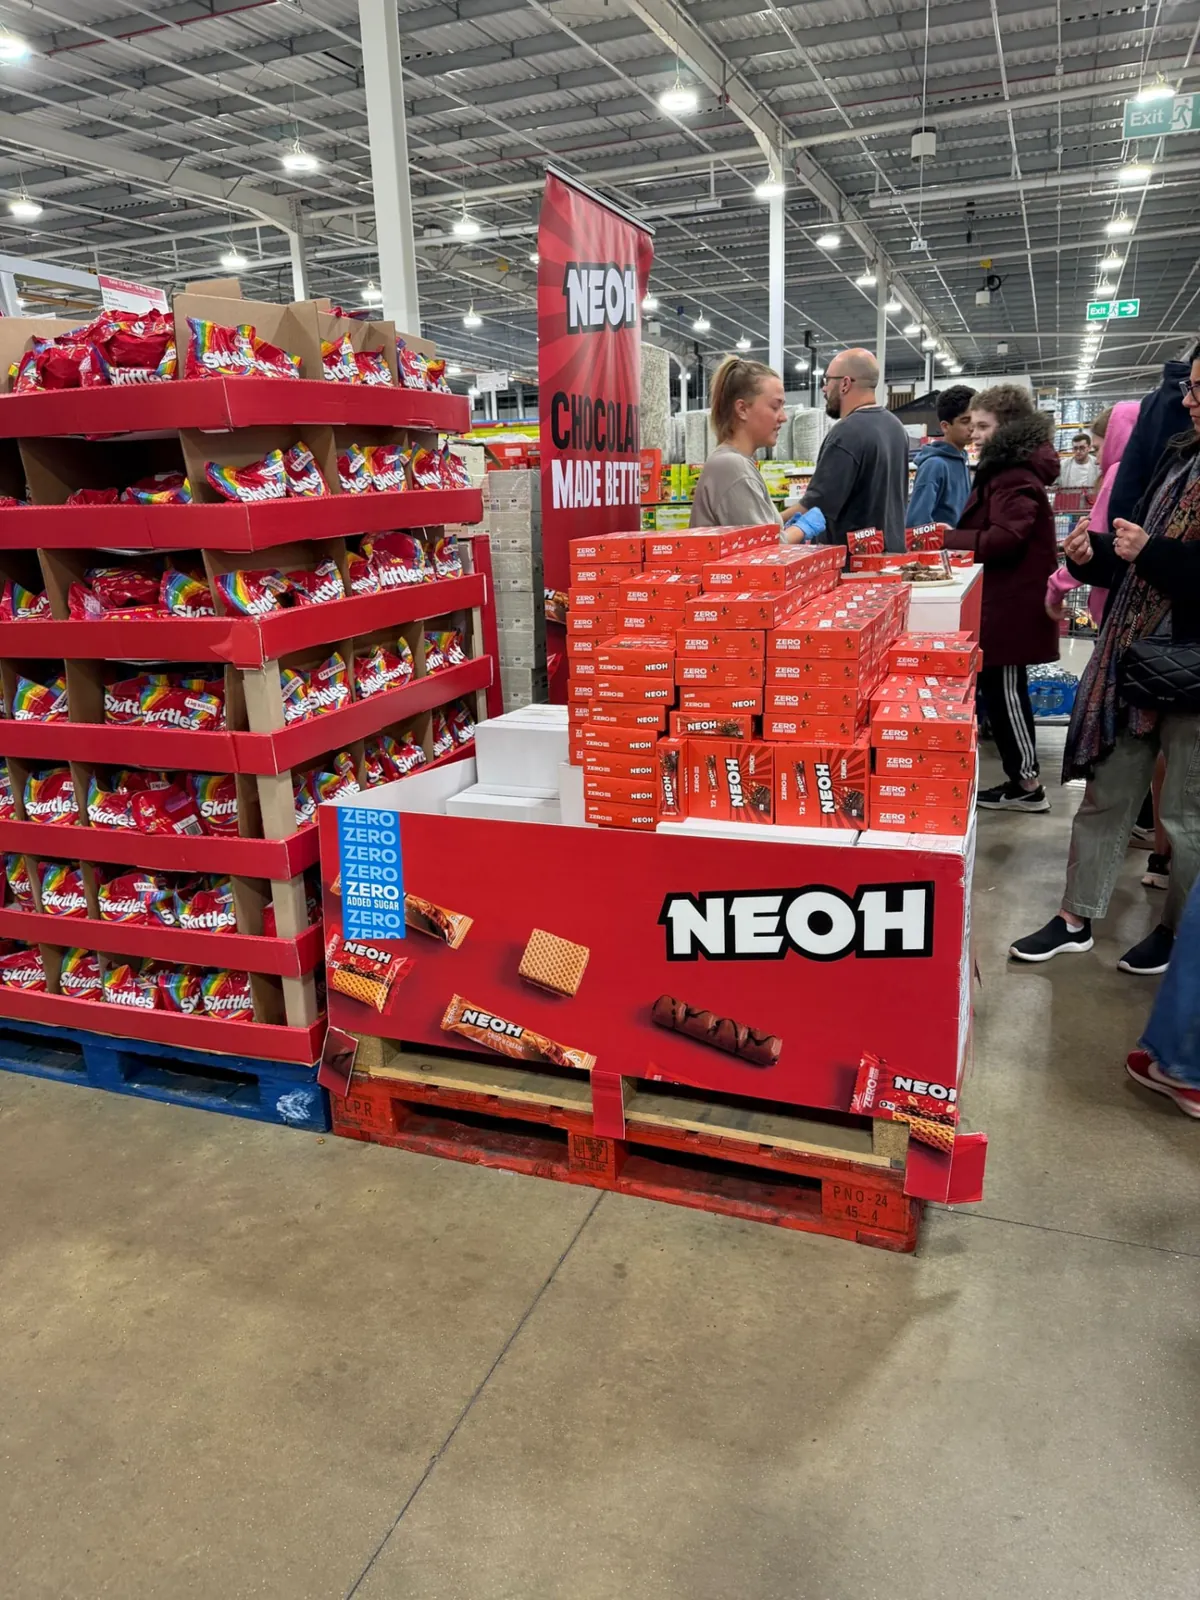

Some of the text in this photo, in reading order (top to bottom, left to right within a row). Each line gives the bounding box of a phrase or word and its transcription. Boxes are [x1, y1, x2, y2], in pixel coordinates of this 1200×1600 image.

[1130, 108, 1165, 127] Exit
[566, 267, 638, 328] NEOH
[1090, 306, 1106, 315] Exit
[551, 459, 602, 510] MADE
[854, 528, 876, 540] NEOH
[912, 523, 937, 536] NEOH
[379, 564, 424, 587] kittles
[694, 610, 718, 618] ZERO
[645, 663, 668, 672] NEOH
[644, 690, 668, 698] NEOH
[104, 694, 141, 715] Skitt
[732, 700, 756, 709] NEOH
[637, 716, 660, 724] NEOH
[687, 721, 717, 732] NEOH
[772, 722, 797, 730] ZERO
[663, 776, 675, 806] NEOH
[725, 758, 744, 808] NEOH
[815, 763, 836, 814] NEOH
[25, 796, 79, 816] Skittles
[200, 799, 238, 817] Skitt
[710, 799, 717, 808] 12
[799, 806, 806, 815] 12
[341, 808, 395, 828] ZERO
[342, 827, 396, 846] ZERO
[343, 845, 398, 864] ZERO
[344, 863, 398, 882] ZERO
[346, 881, 399, 901] ZERO
[347, 897, 400, 911] ADDED SUGAR
[178, 910, 237, 930] Skittles
[347, 909, 400, 929] ZERO
[664, 886, 929, 958] NEOH
[343, 940, 393, 964] NEOH
[203, 994, 253, 1013] Skittle
[460, 1009, 524, 1039] NEOH
[863, 1078, 877, 1108] ZERO
